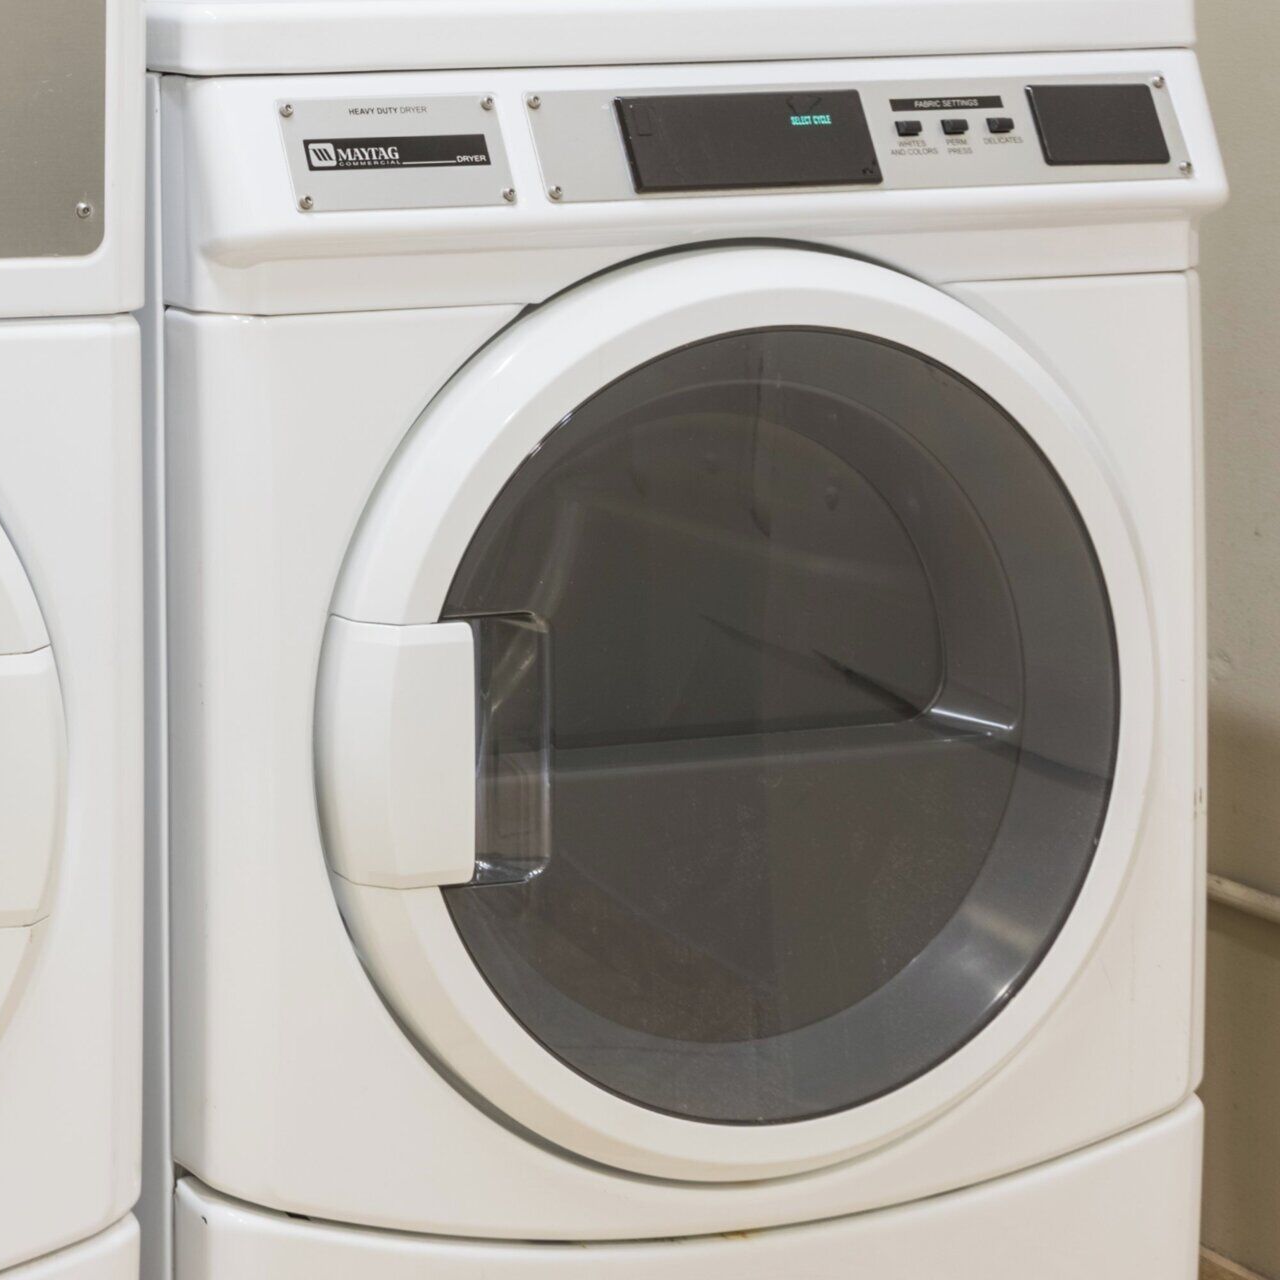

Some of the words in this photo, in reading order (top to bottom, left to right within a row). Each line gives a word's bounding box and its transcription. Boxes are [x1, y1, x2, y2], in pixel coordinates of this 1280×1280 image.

[914, 100, 941, 108] FABRIC
[942, 99, 979, 107] SETTINGS
[349, 107, 375, 115] HEAVY
[400, 106, 427, 114] DRYER
[790, 115, 812, 125] SELECT
[812, 115, 832, 124] CYCLE
[983, 137, 1024, 145] DELICATES
[337, 146, 400, 161] MAYTAG
[891, 148, 906, 156] AND
[908, 148, 939, 156] COLORS
[339, 159, 401, 167] COMMERCIAL
[456, 155, 487, 163] DRYER
